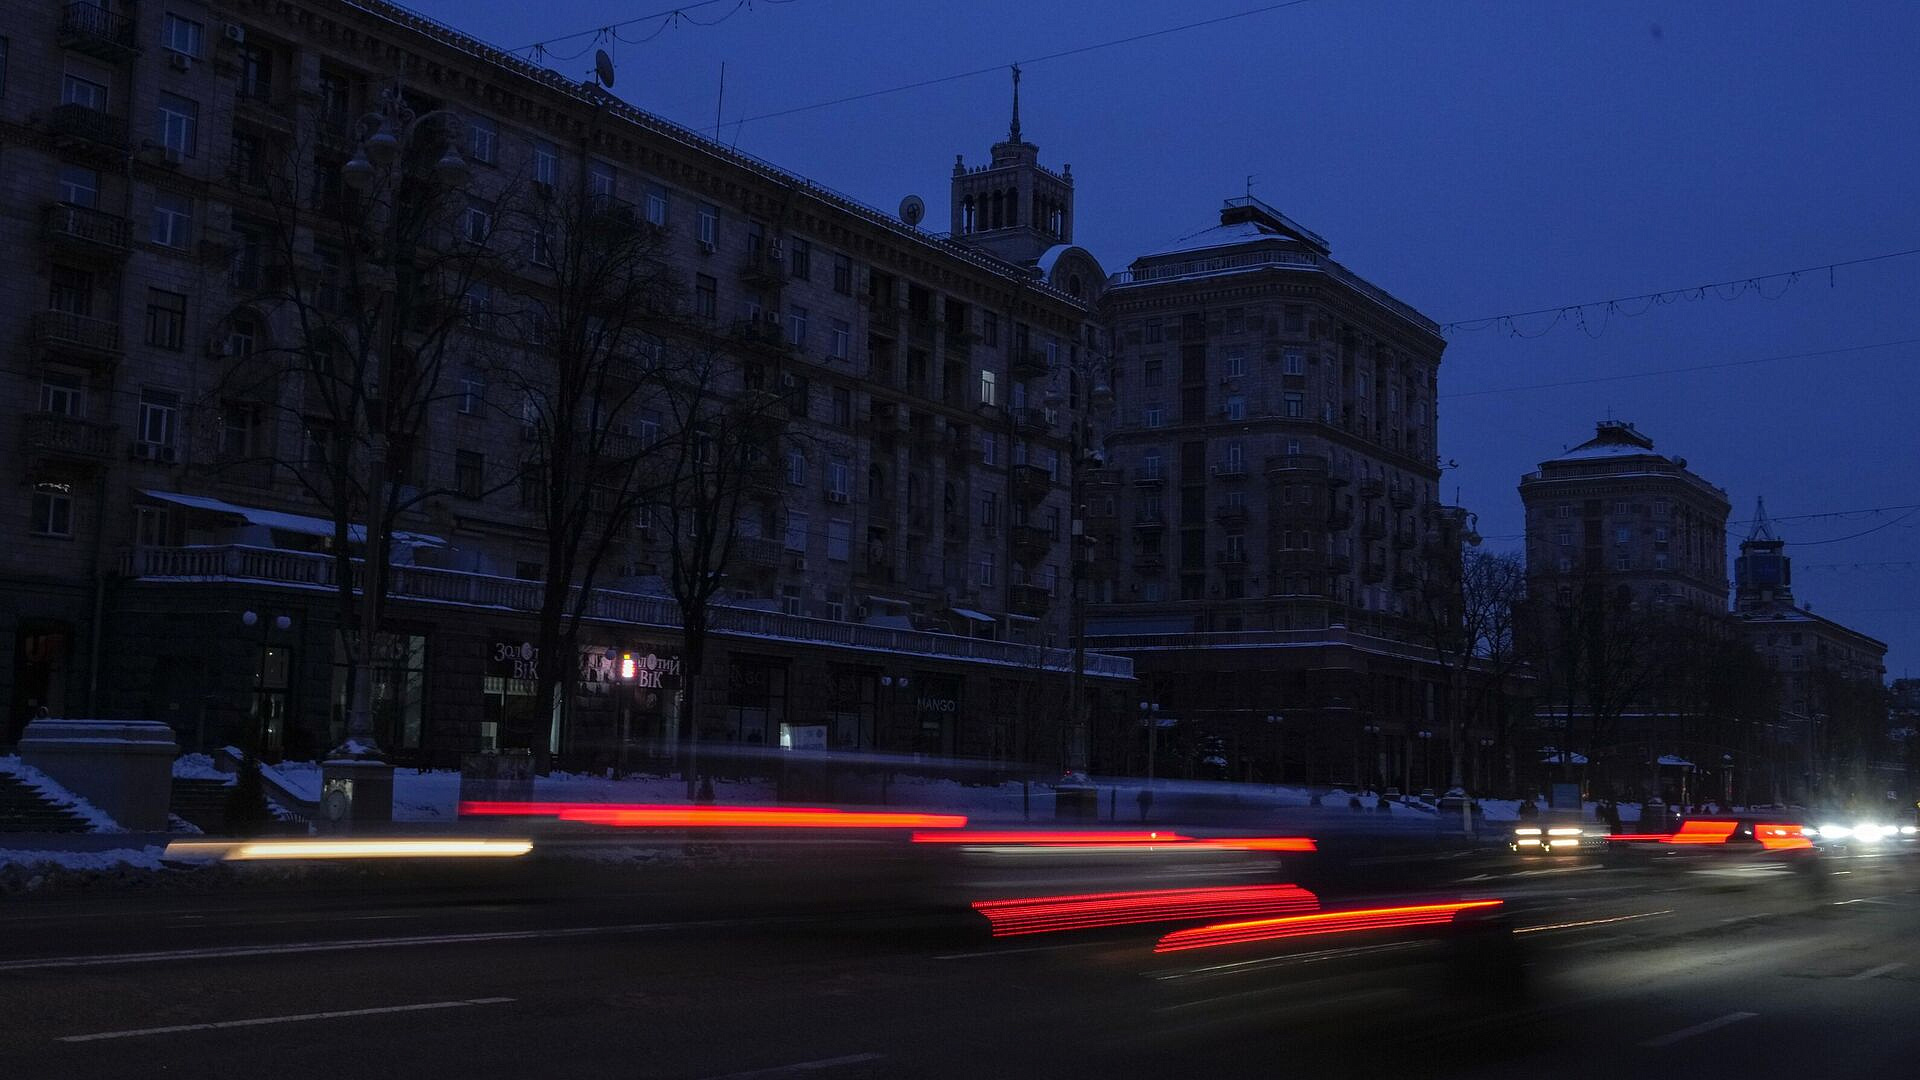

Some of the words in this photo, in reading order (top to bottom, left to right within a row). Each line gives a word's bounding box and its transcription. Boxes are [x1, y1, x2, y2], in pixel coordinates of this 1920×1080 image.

[512, 660, 540, 680] ВІК
[639, 670, 664, 689] ВІК
[917, 696, 956, 712] MANGO
